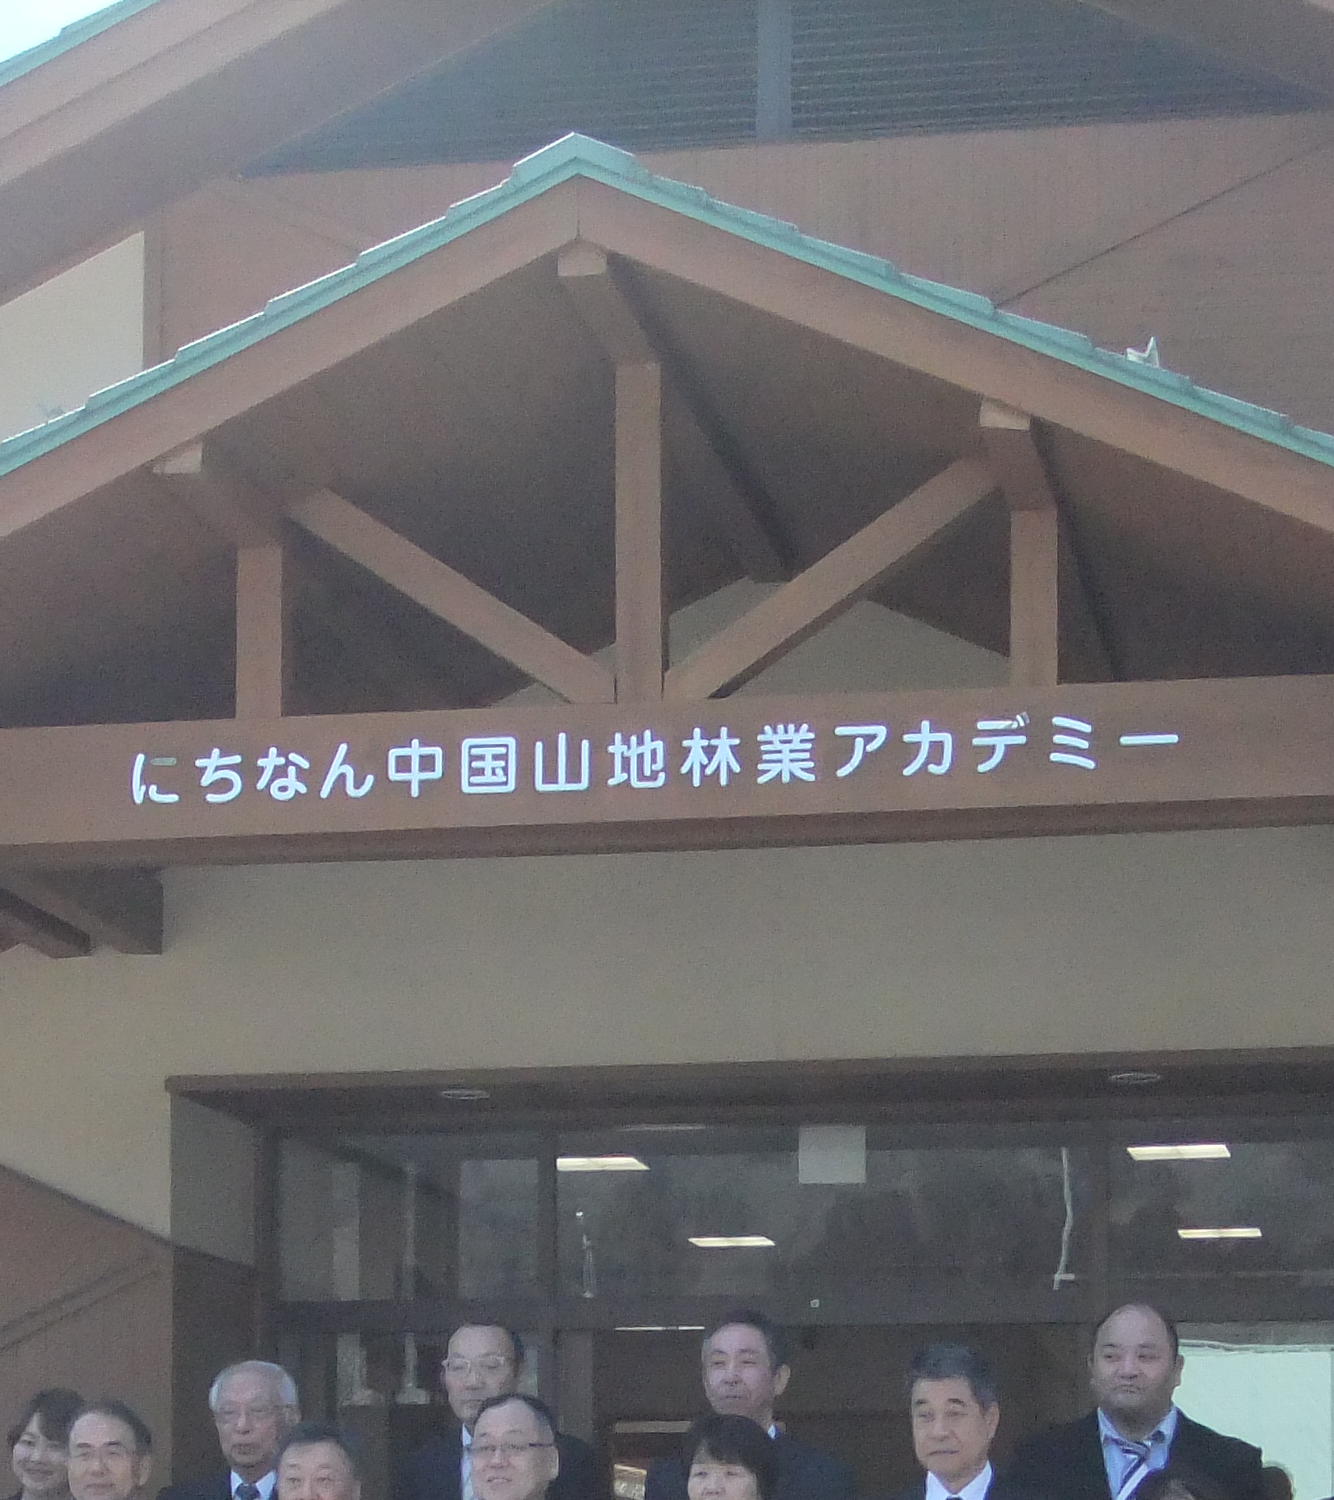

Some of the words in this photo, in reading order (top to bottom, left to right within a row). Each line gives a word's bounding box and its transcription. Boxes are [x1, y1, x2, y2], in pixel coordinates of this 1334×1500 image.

[131, 715, 1183, 806] にちなん中国山地林業アカデミー
